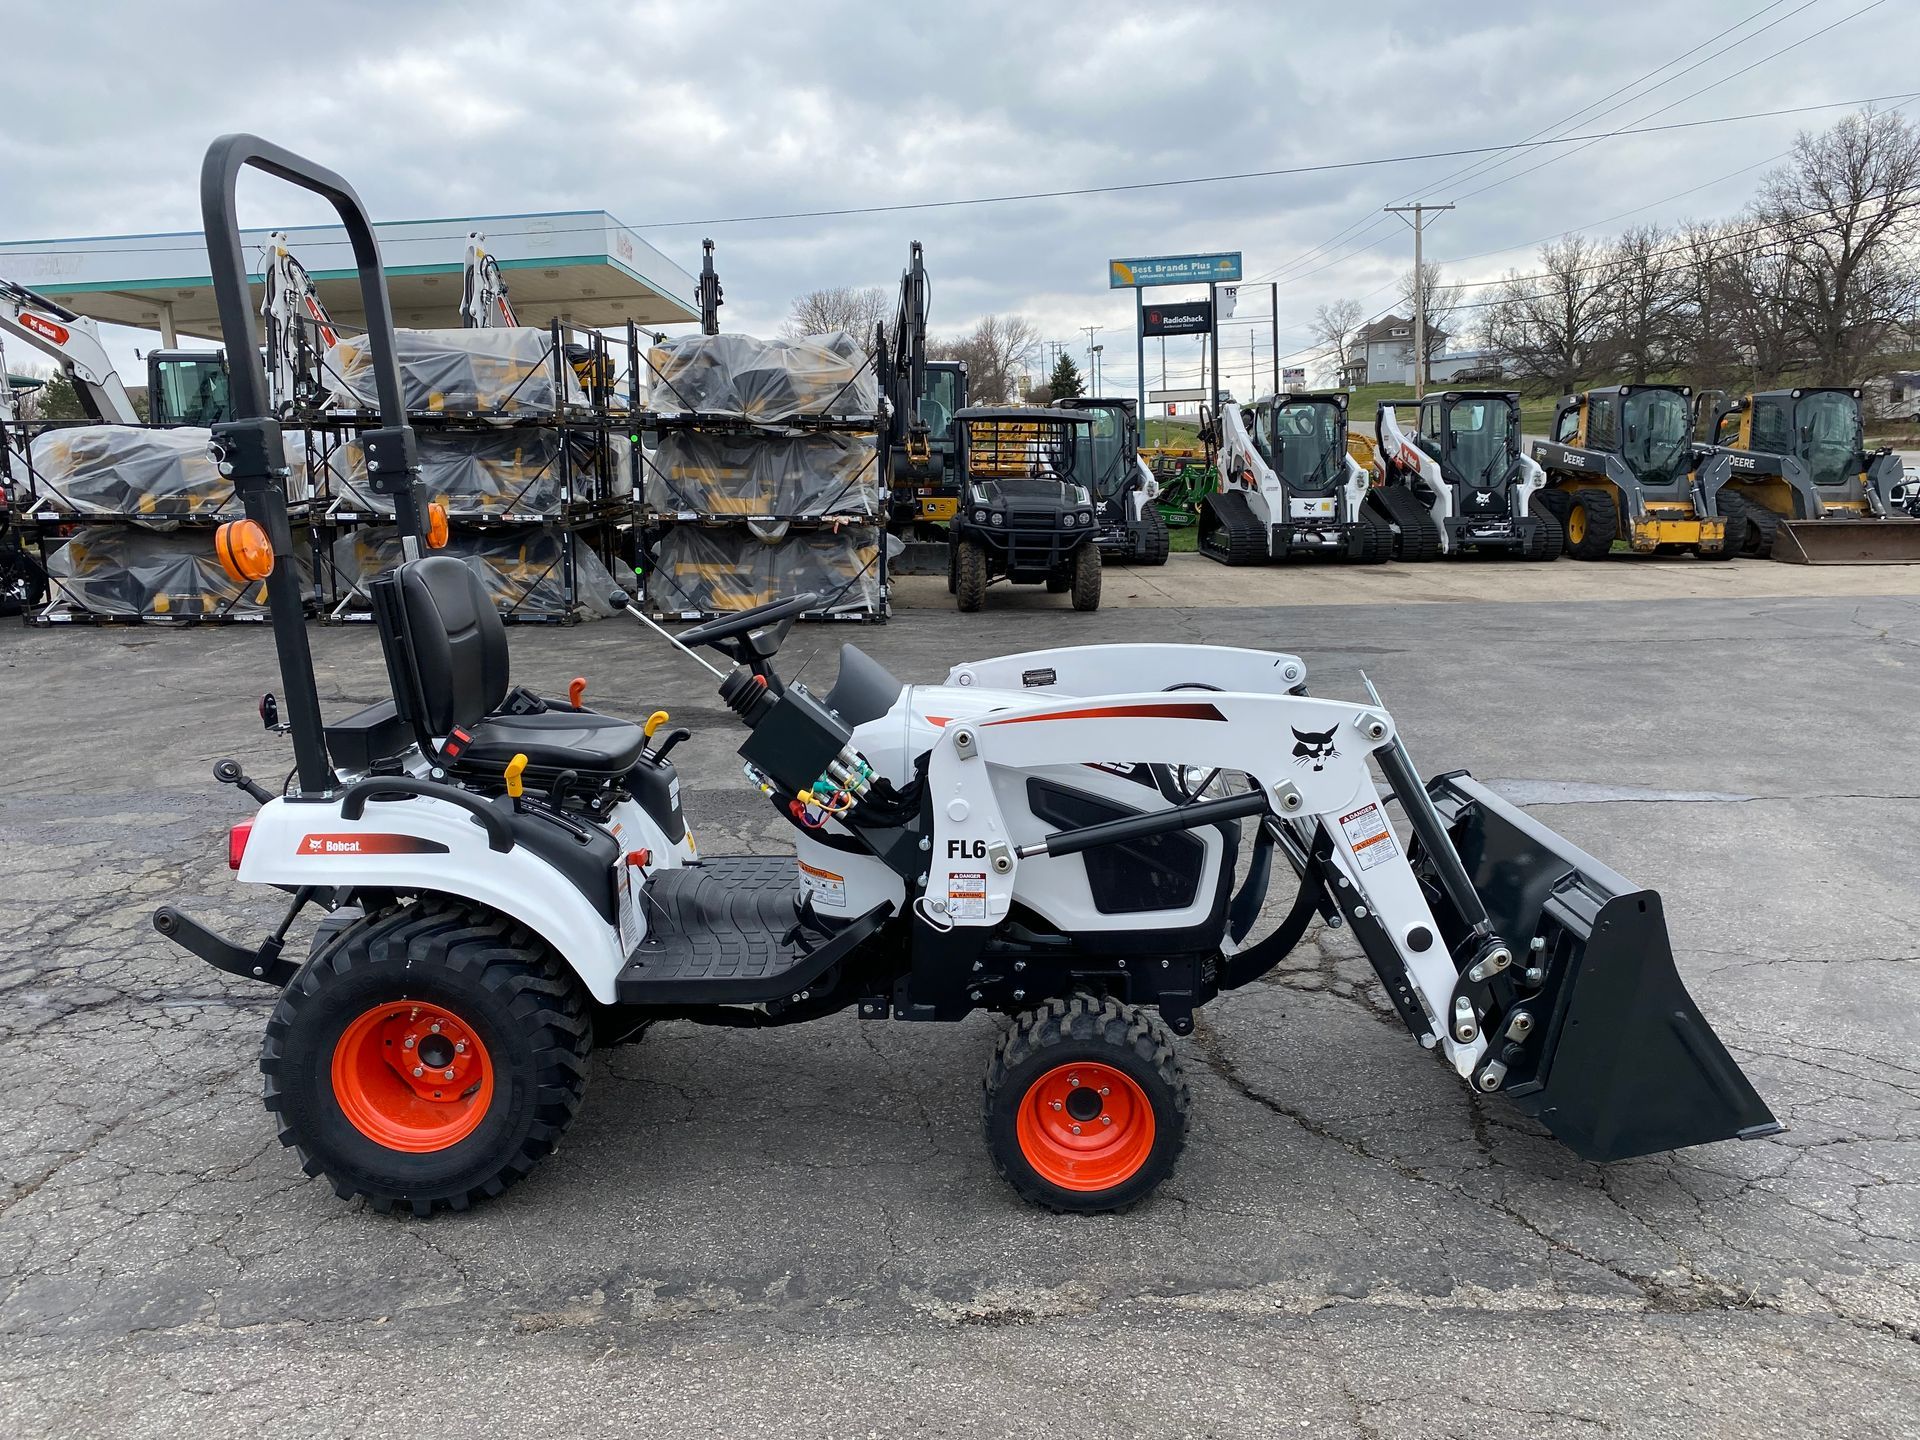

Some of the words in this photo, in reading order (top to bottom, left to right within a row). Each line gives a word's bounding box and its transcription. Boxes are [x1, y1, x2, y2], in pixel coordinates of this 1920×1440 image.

[1131, 265, 1152, 274] Best
[1155, 263, 1188, 272] Brands
[1191, 262, 1211, 270] Plus
[1163, 315, 1204, 324] RadioShack
[39, 323, 56, 339] Bobcat
[1563, 451, 1585, 467] DEERE
[1728, 454, 1756, 469] DEERE
[1349, 805, 1374, 819] DANGER
[325, 840, 360, 852] Bobcat
[1361, 833, 1386, 847] WARNING
[947, 839, 987, 859] FL6
